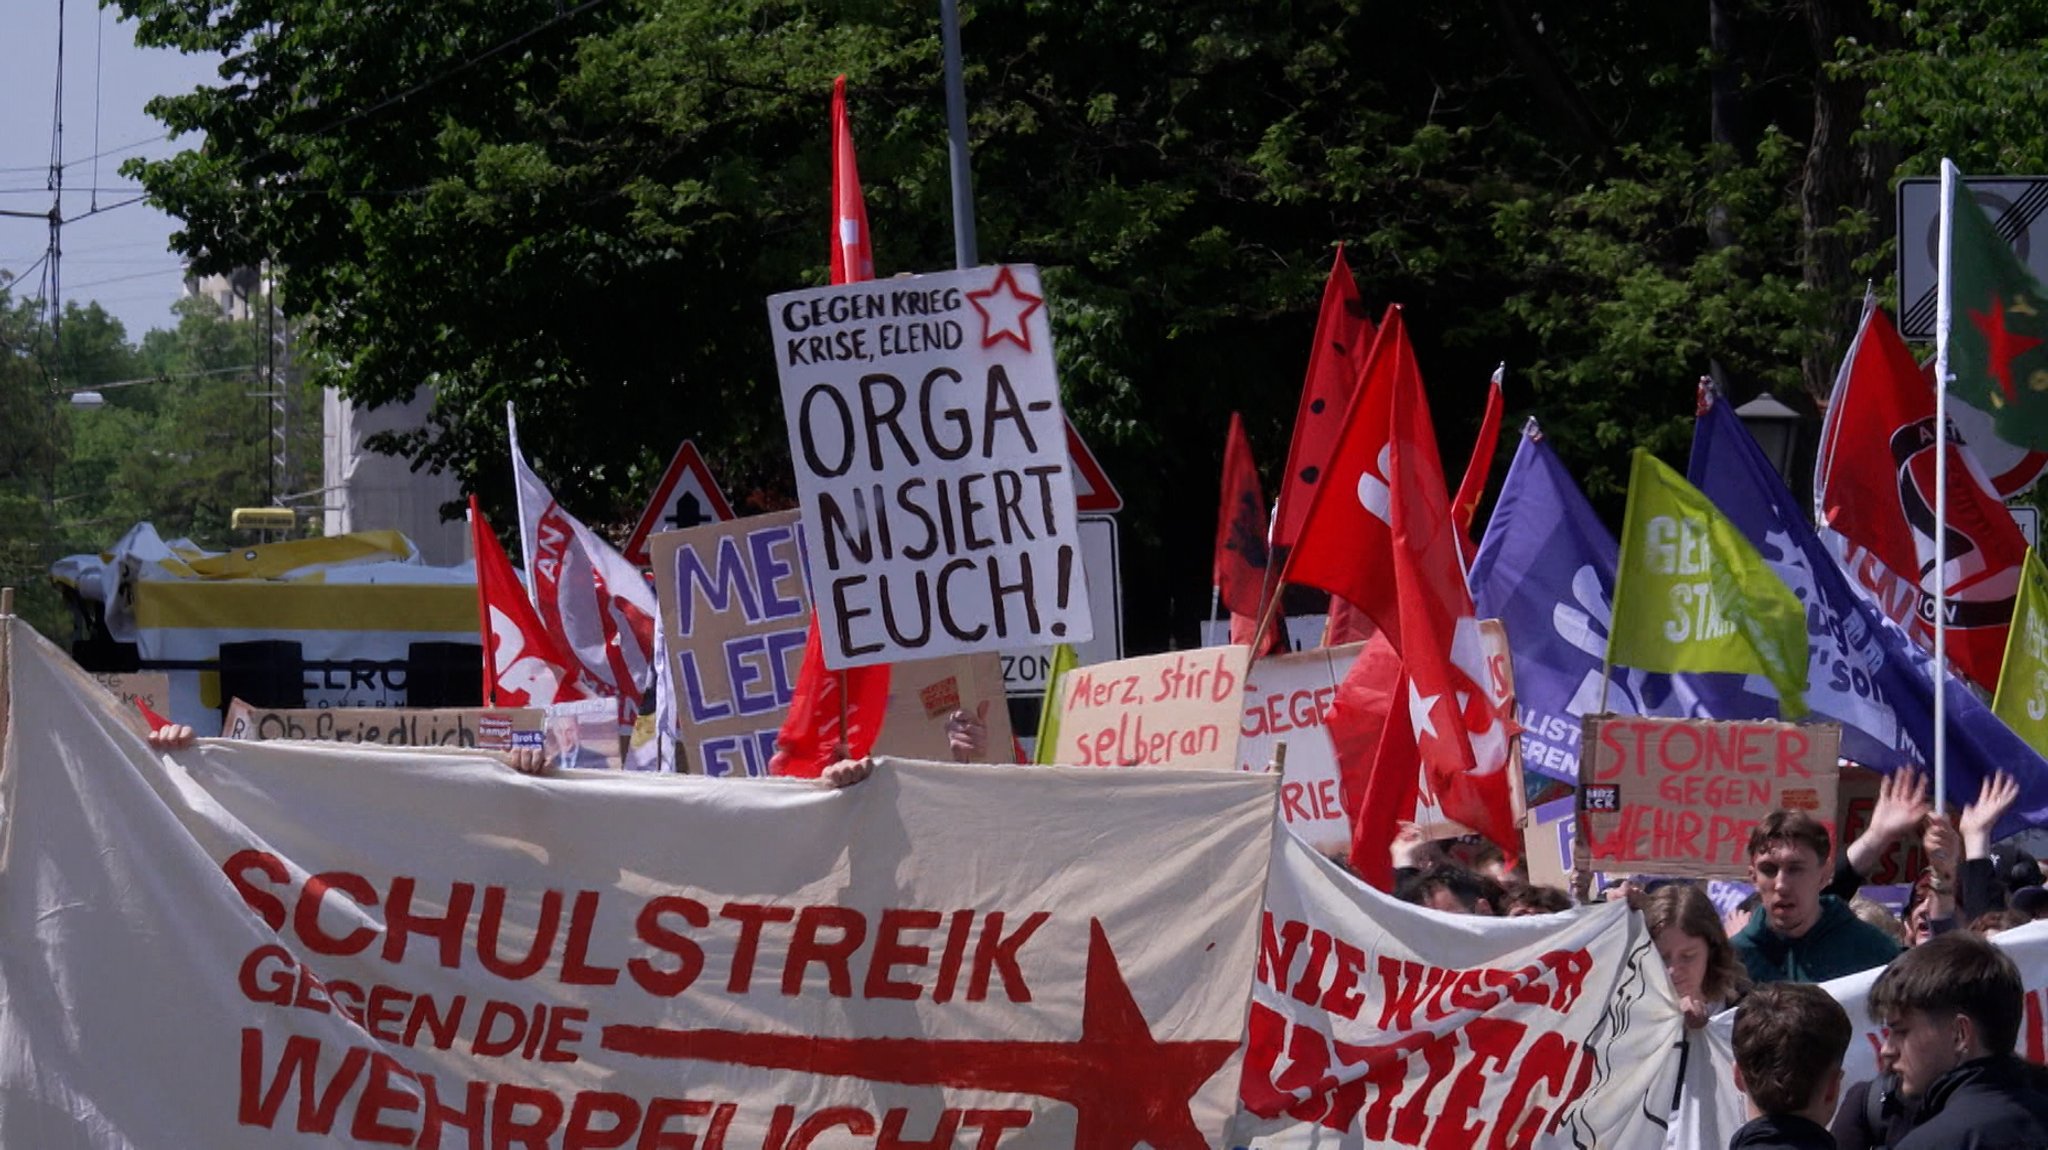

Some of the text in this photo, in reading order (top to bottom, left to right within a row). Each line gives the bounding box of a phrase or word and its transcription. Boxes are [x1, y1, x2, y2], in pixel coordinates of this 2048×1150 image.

[782, 286, 961, 333] GEGEN KRIEG
[787, 319, 964, 367] KRISE, ELEND
[800, 364, 1053, 478] ORGA-
[817, 465, 1062, 571] NISIERT
[832, 545, 1073, 658] EUCH!
[1069, 672, 1144, 711] Merz,
[1595, 720, 1812, 781] STONER
[1659, 776, 1773, 810] GEGEN
[222, 849, 1053, 1004] SCHULSTREIK
[1256, 911, 1367, 1021] NIE
[238, 945, 589, 1063] GEGEN DIE
